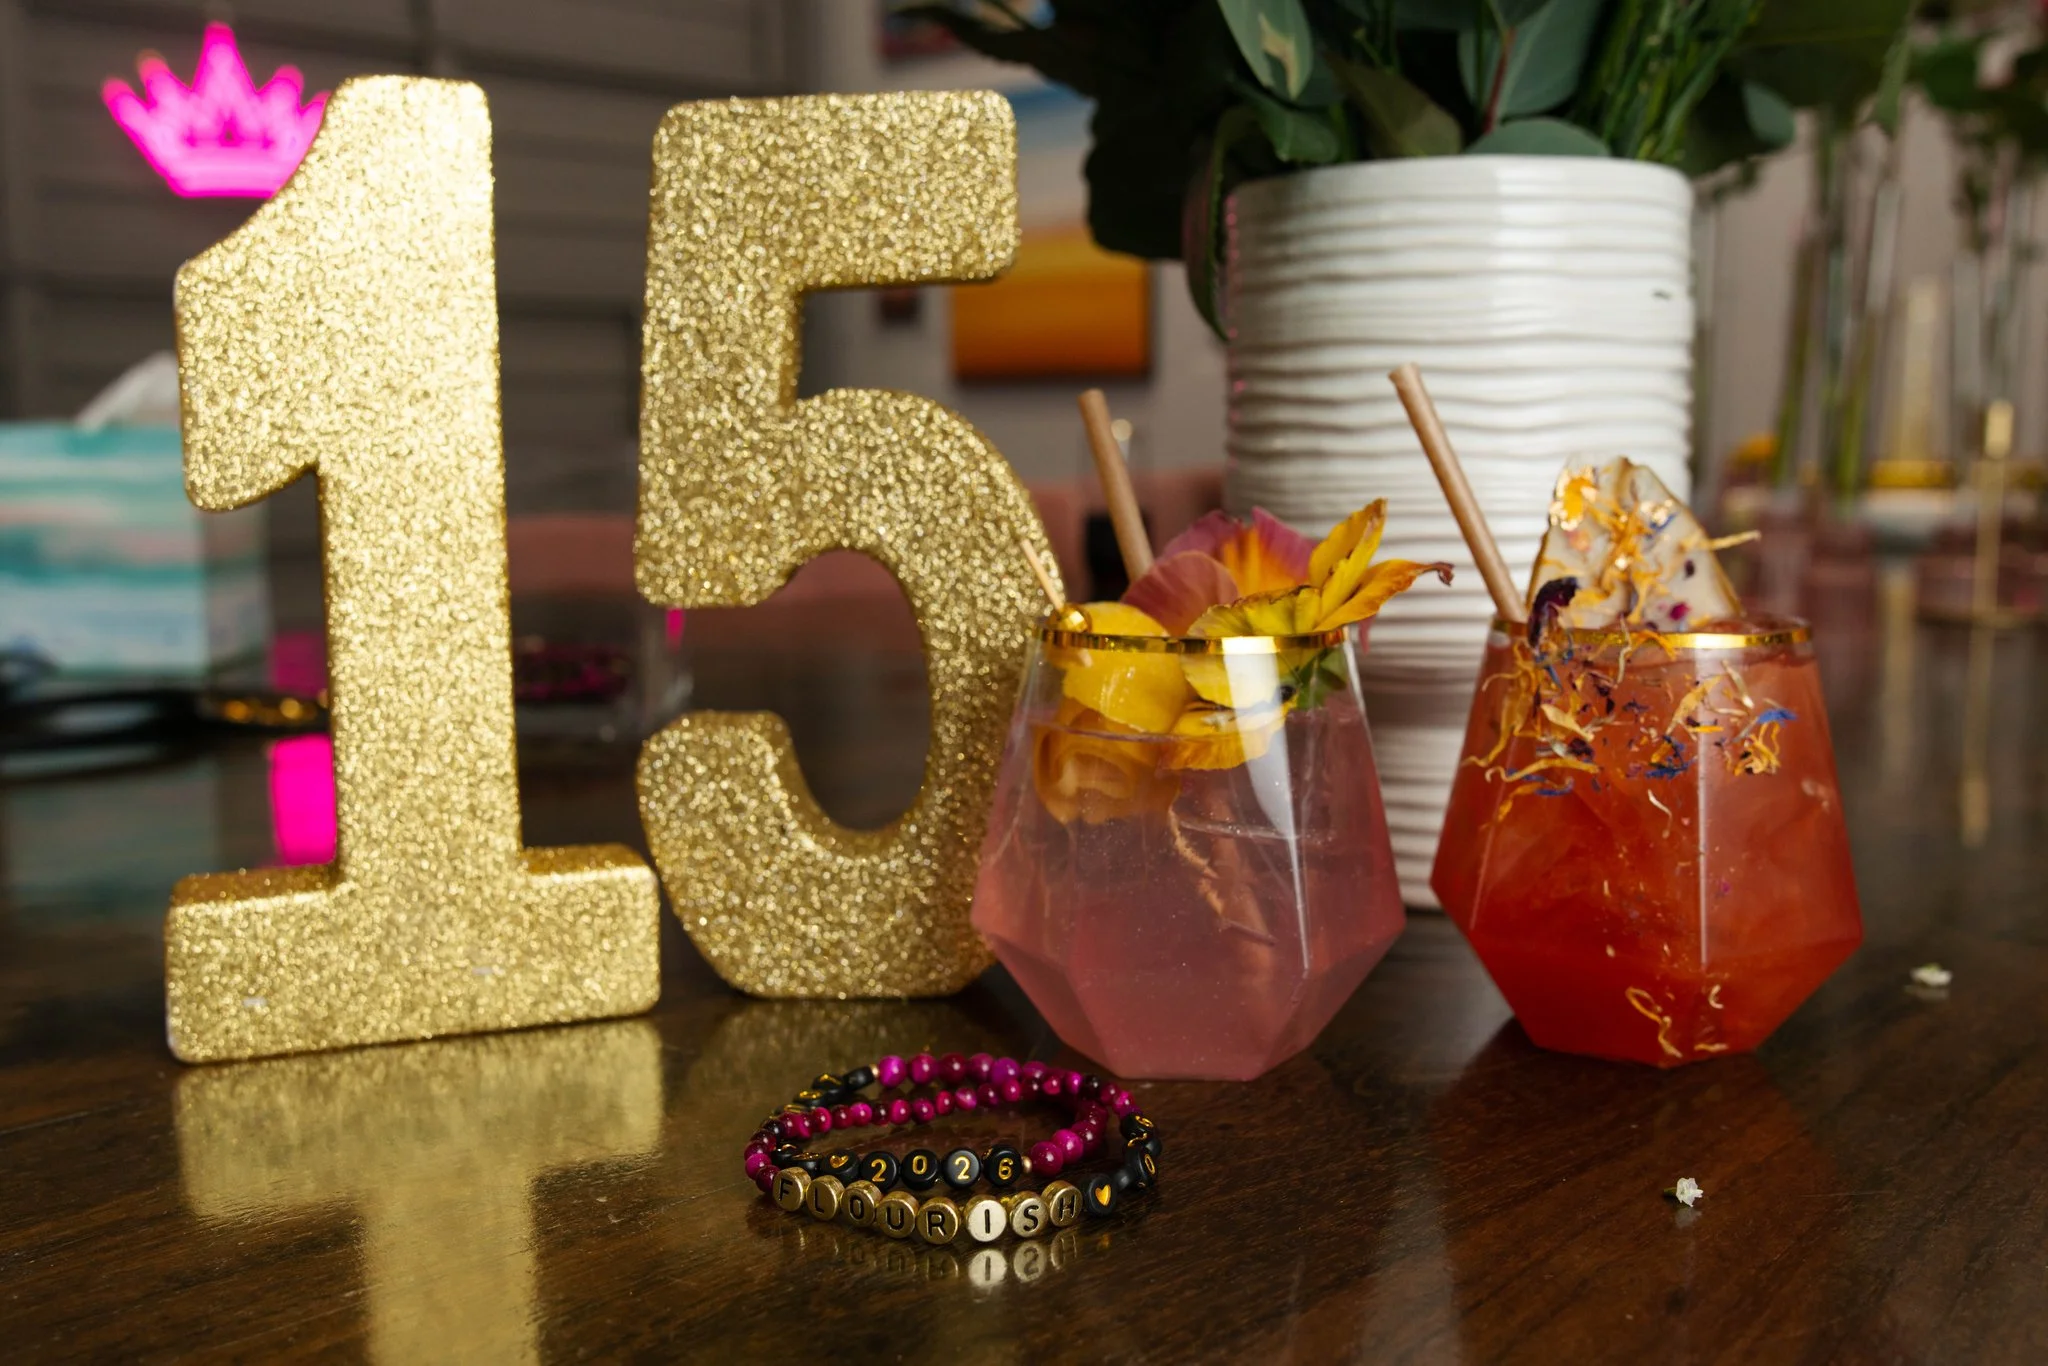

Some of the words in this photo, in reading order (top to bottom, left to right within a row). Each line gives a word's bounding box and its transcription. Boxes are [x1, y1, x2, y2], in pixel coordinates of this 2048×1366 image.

[165, 75, 1066, 1064] 15
[869, 1153, 1015, 1183] 2026
[778, 1177, 1077, 1238] FLOURISH
